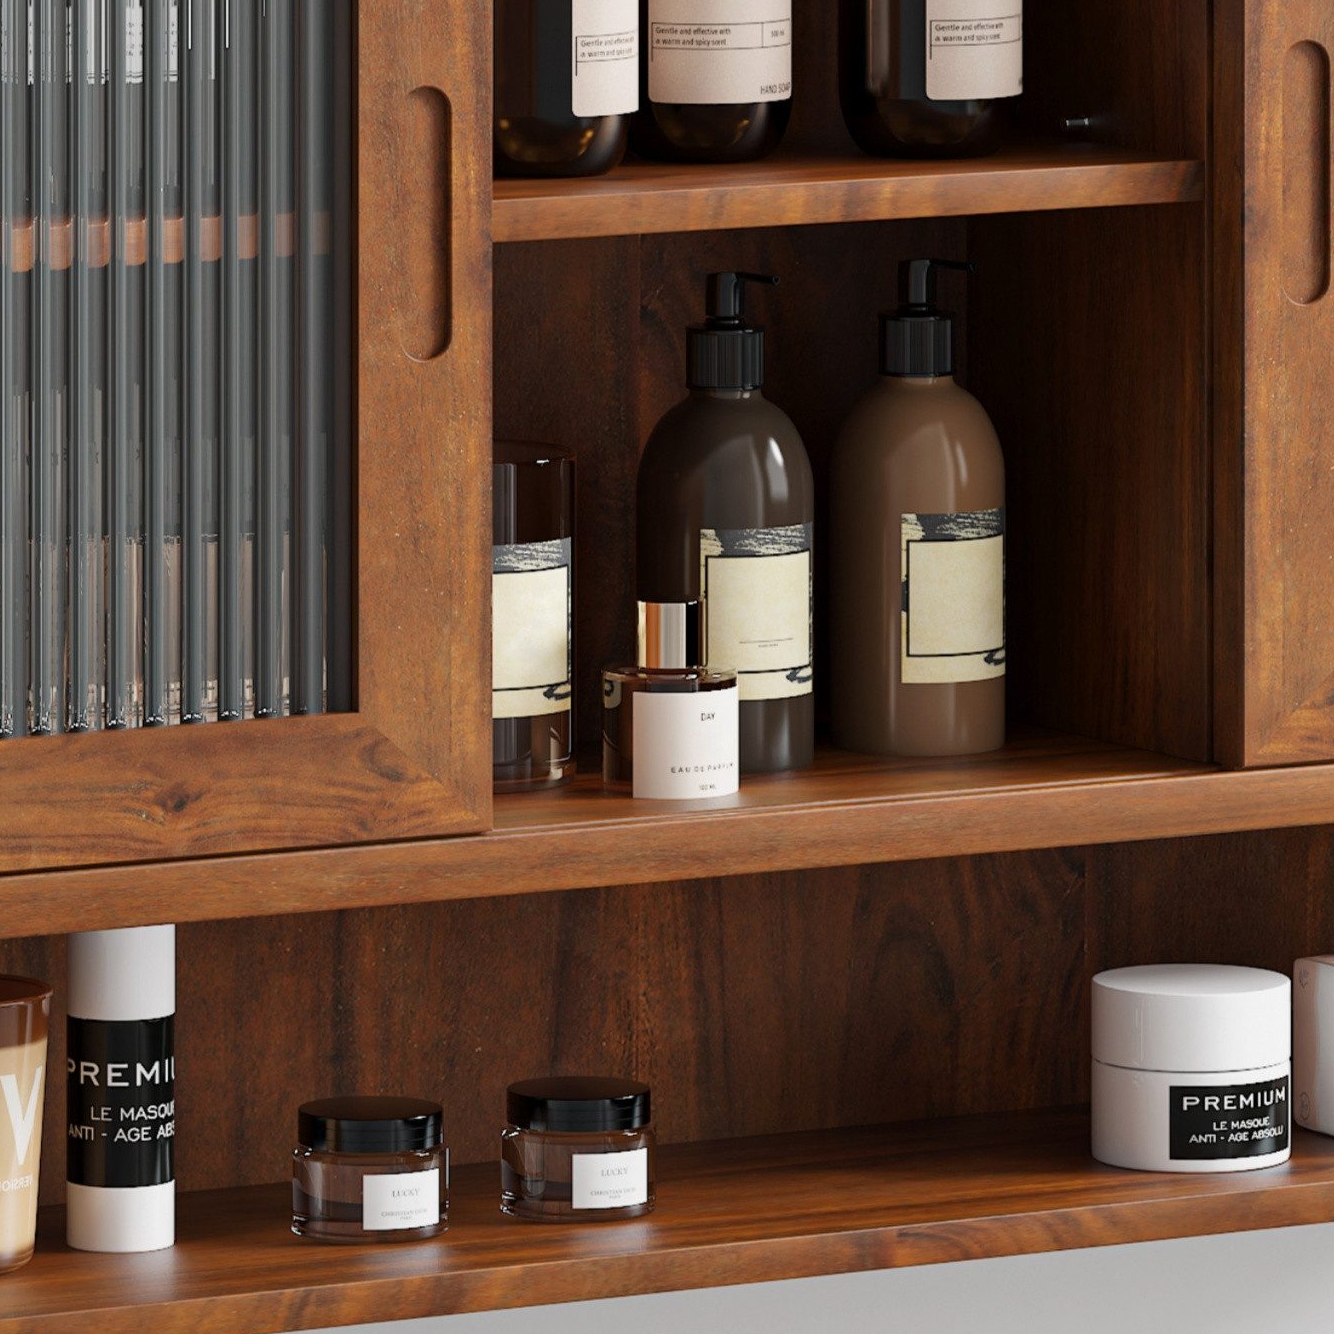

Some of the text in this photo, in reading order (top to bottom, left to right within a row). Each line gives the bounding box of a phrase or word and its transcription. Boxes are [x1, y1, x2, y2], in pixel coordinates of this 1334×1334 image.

[655, 27, 678, 36] Gentle
[679, 27, 692, 36] and
[693, 27, 718, 36] effective
[934, 24, 960, 32] Gentle
[580, 38, 604, 48] Gentle
[662, 36, 680, 45] warm
[681, 36, 694, 46] and
[695, 36, 711, 47] spicy
[963, 33, 975, 42] and
[760, 84, 777, 95] HAND
[701, 712, 716, 722] DAY
[670, 766, 691, 774] EAU
[1182, 1085, 1287, 1112] PREMIUM
[90, 1099, 175, 1122] LE MASQU
[1212, 1115, 1271, 1131] LE MASQUE
[68, 1123, 95, 1141] ANTI
[114, 1125, 153, 1143] AGE
[1188, 1133, 1217, 1144] ANTI
[1227, 1130, 1250, 1143] AGE
[1250, 1124, 1285, 1140] ABSOLU
[600, 1167, 628, 1178] LUCKY
[391, 1187, 419, 1198] LUCKY
